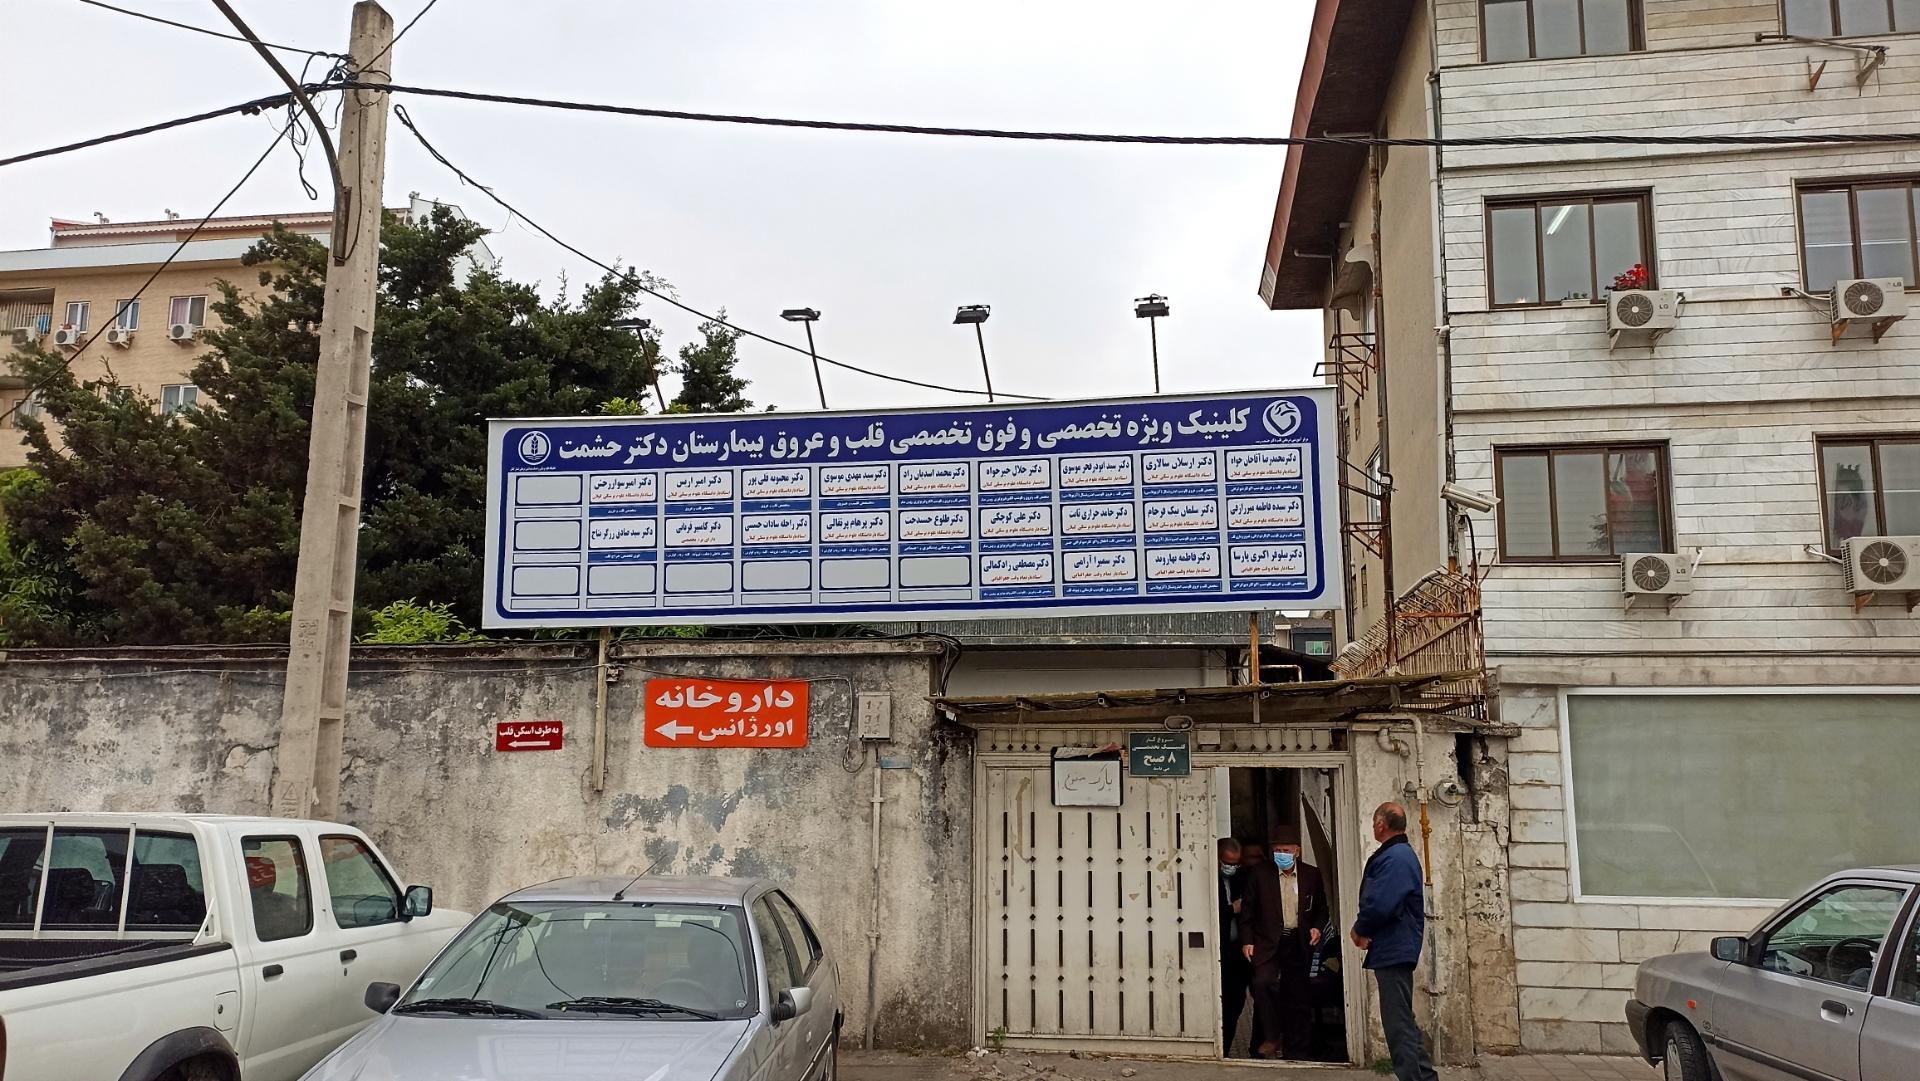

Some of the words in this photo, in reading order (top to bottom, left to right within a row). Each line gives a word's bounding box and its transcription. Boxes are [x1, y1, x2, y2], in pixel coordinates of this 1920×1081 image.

[1127, 413, 1172, 444] ویژه
[1178, 407, 1250, 440] کلینیک
[977, 416, 1017, 451] فوق
[1037, 413, 1121, 449] تخصصی
[845, 420, 884, 455] قلب
[889, 420, 972, 455] تخصصی
[1018, 428, 1031, 450] و
[559, 434, 622, 459] حشمت
[624, 432, 668, 464] دکتر
[672, 428, 764, 462] بیمارستان
[770, 431, 824, 459] عروق
[828, 435, 839, 457] و
[1145, 458, 1169, 470] سالاری
[1171, 457, 1194, 469] ارسلان
[1197, 456, 1212, 468] دکتر
[1285, 453, 1296, 465] دکتر
[1028, 464, 1041, 476] دکتر
[1118, 460, 1129, 472] دکتر
[790, 472, 804, 484] دکتر
[824, 474, 844, 483] موسوی
[845, 473, 861, 482] مهدی
[874, 469, 887, 481] دکتر
[935, 469, 952, 477] محمد
[952, 467, 965, 479] دکتر
[638, 477, 651, 489] دکتر
[695, 476, 706, 488] امیر
[708, 475, 721, 487] دکتر
[1115, 507, 1127, 519] دکتر
[1200, 504, 1213, 517] دکتر
[1287, 501, 1299, 513] دکتر
[869, 516, 883, 529] دکتر
[950, 513, 963, 526] دکتر
[1014, 512, 1026, 523] علی
[1027, 510, 1041, 523] دکتر
[710, 521, 721, 533] دکتر
[796, 518, 807, 530] دکتر
[630, 529, 640, 538] سید
[641, 526, 653, 539] دکتر
[1074, 554, 1092, 568] آرامی
[1112, 555, 1125, 567] دکتر
[1197, 551, 1210, 564] دکتر
[1288, 549, 1302, 562] دکتر
[1012, 558, 1036, 571] مصطفی
[1036, 558, 1049, 570] دکتر
[500, 726, 514, 736] قلب
[514, 725, 534, 737] اسکن
[535, 725, 551, 737] طرف
[551, 727, 559, 736] به
[698, 716, 793, 742] اورژانس
[1143, 755, 1165, 767] صبح
[1168, 752, 1176, 763] ۸
[1088, 761, 1113, 791] پارک
